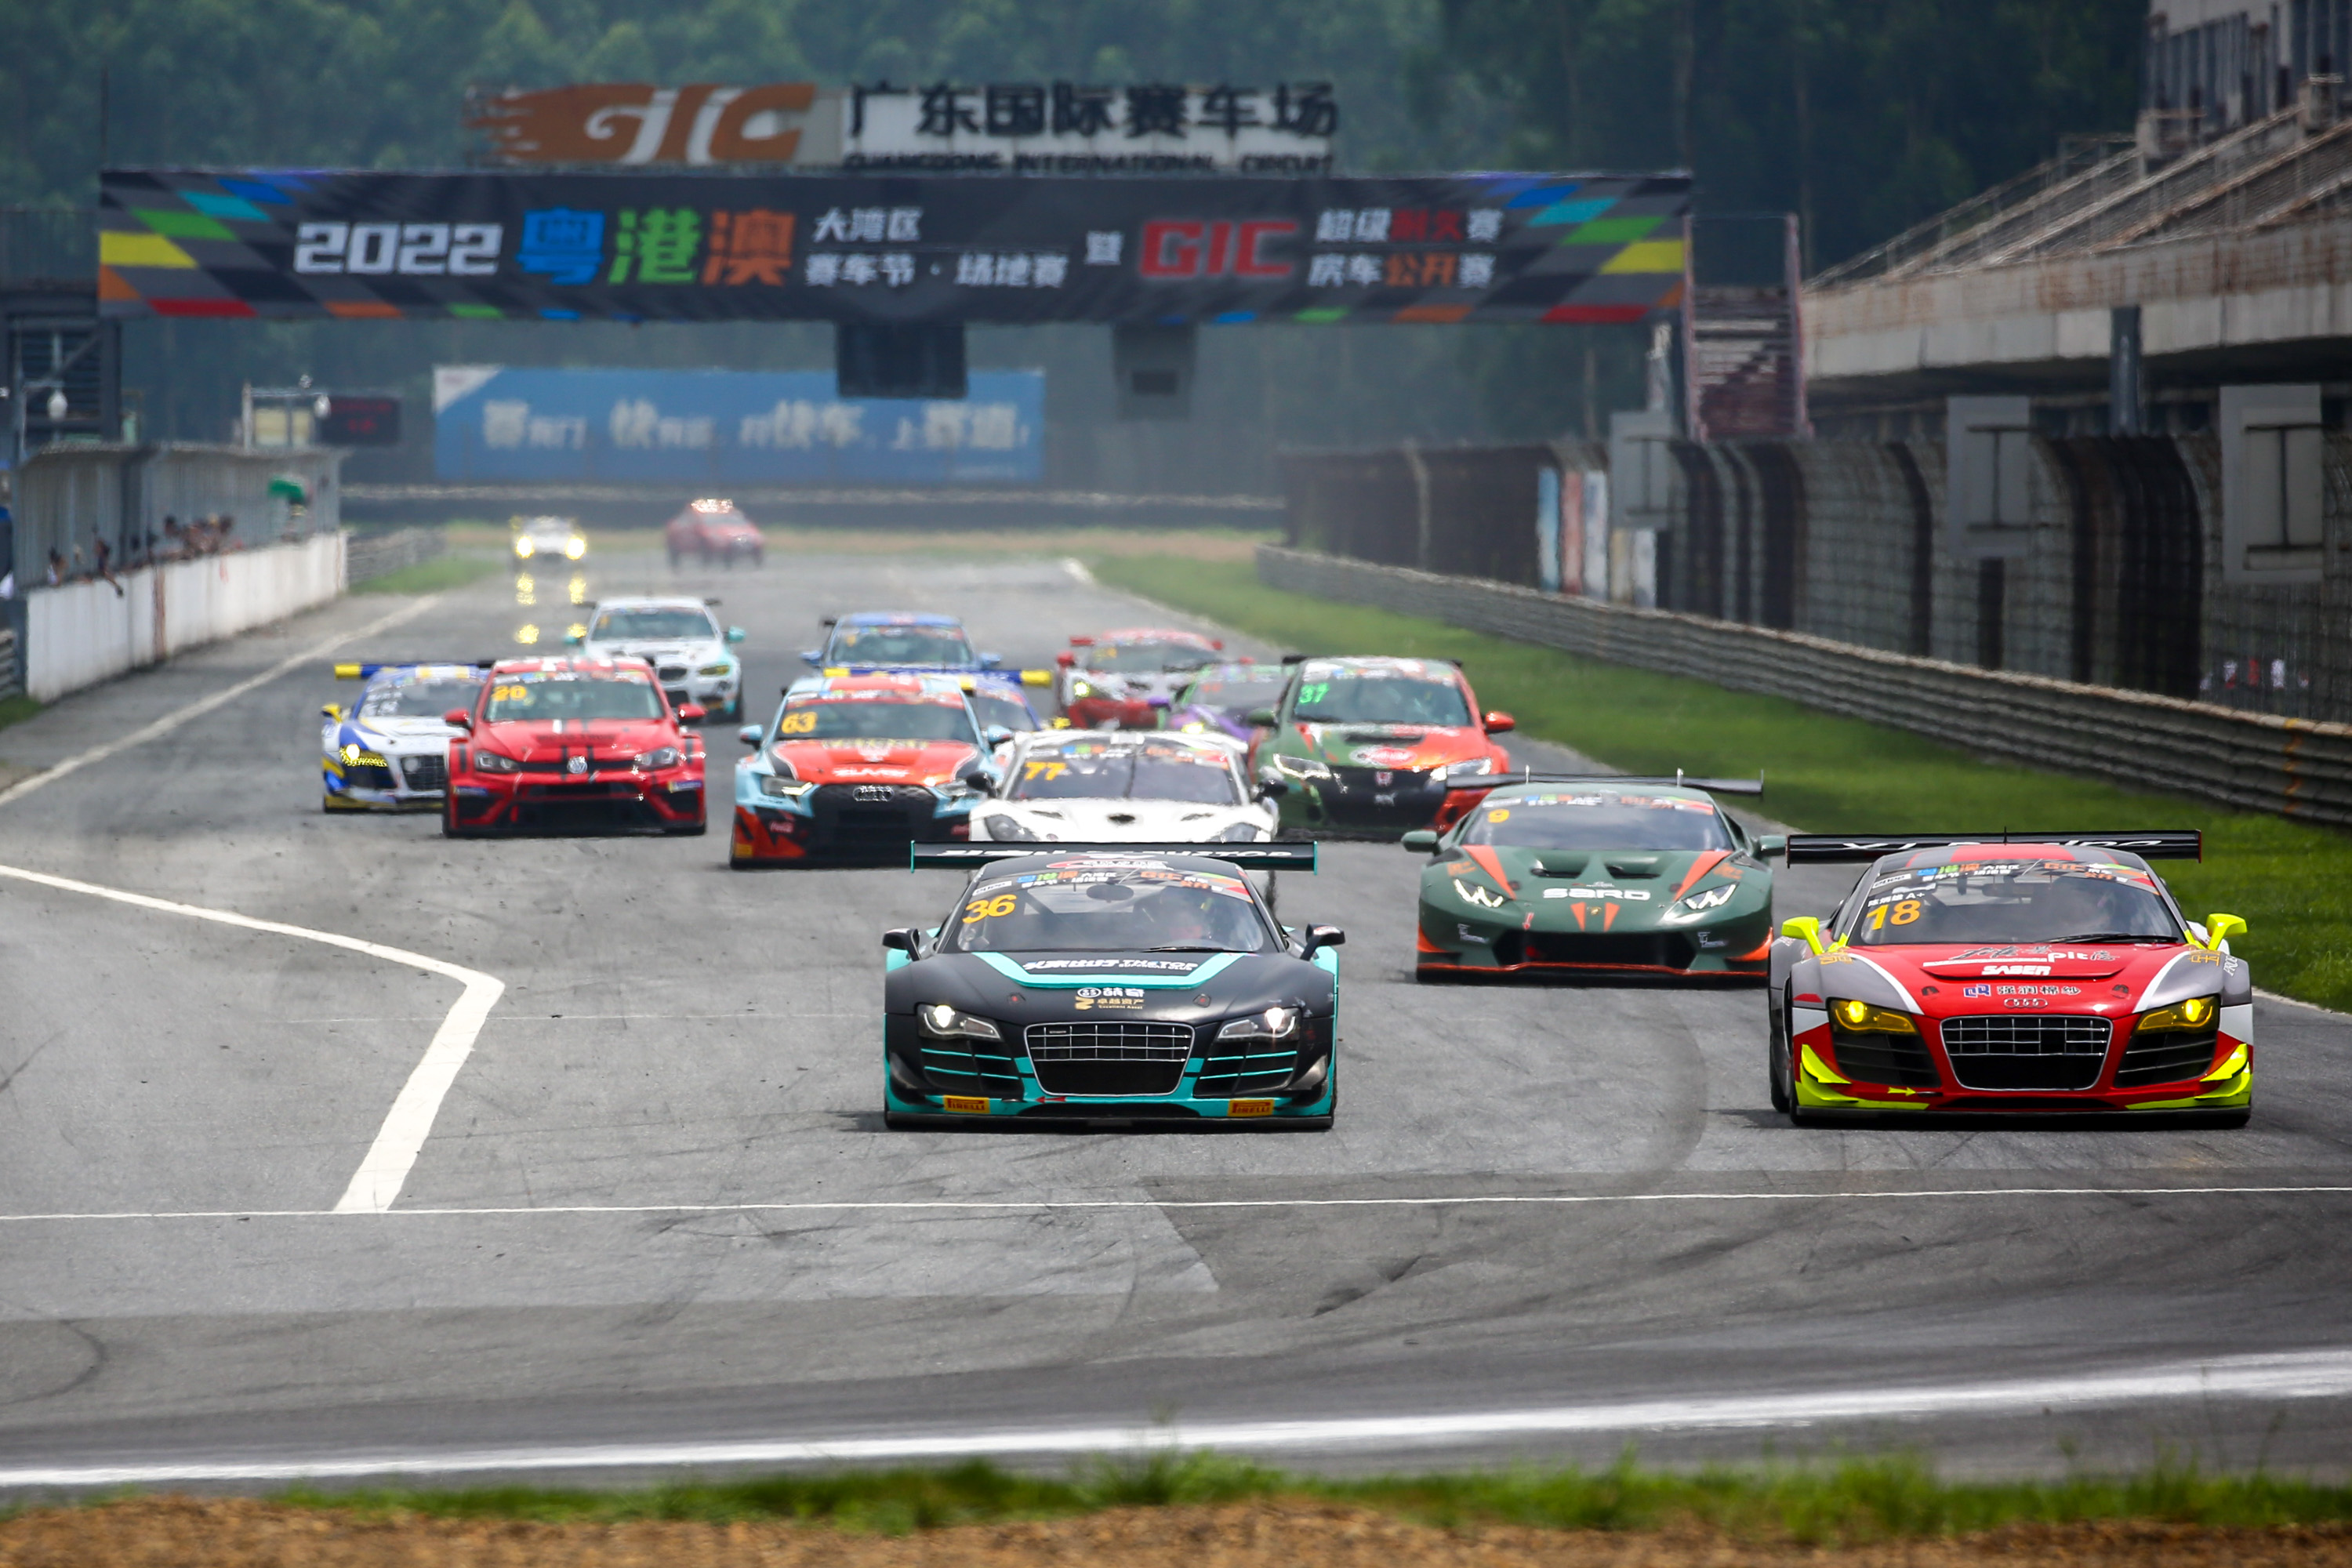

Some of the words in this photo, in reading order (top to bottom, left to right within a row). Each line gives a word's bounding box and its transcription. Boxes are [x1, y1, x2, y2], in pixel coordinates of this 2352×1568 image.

[851, 82, 1338, 140] 广东国际赛车场
[813, 205, 924, 243] 大湾区
[293, 221, 503, 275] 2022
[516, 206, 797, 286] 粤港澳
[1139, 220, 1298, 278] GIC
[491, 684, 527, 702] 20
[1298, 682, 1330, 704] 37
[781, 711, 818, 734] 63
[1025, 761, 1067, 781] 77
[1487, 808, 1510, 823] 9
[2043, 862, 2086, 873] GIC
[962, 893, 1018, 924] 36
[1866, 899, 1922, 931] 18
[946, 1098, 985, 1111] PIRELLI
[1232, 1102, 1272, 1113] PIRELLI
